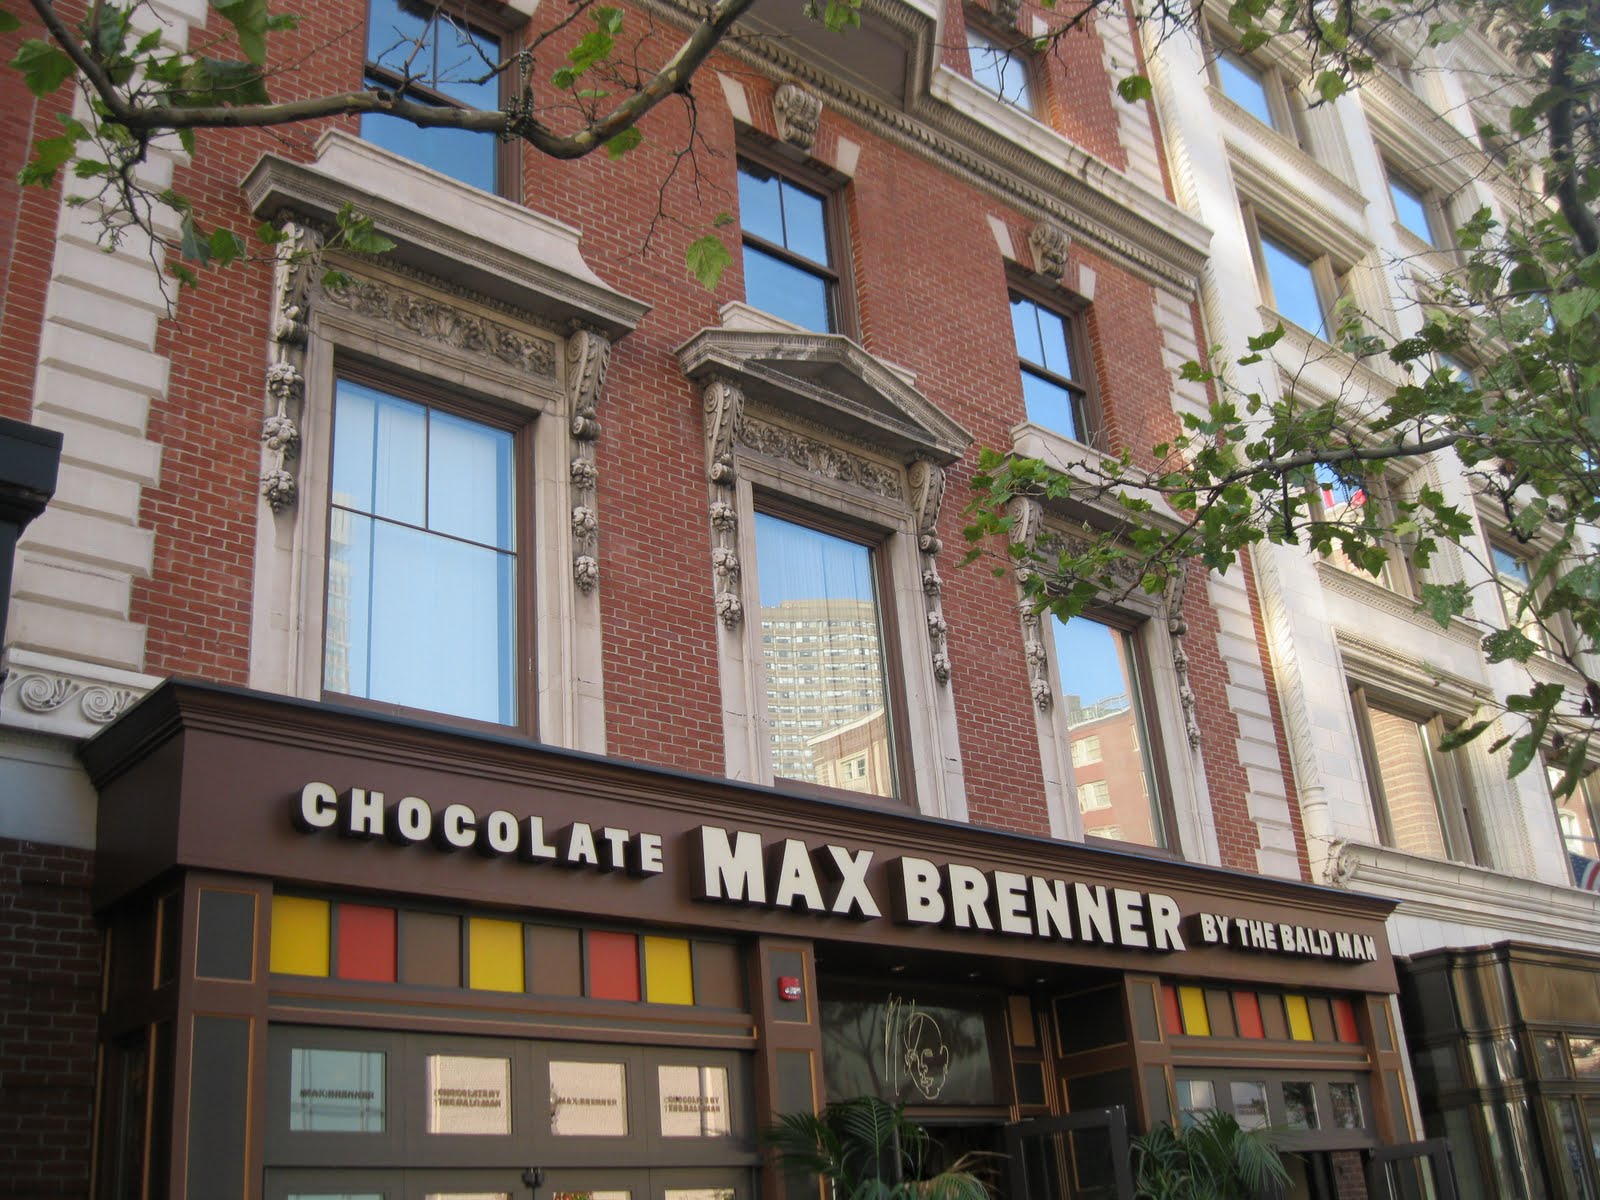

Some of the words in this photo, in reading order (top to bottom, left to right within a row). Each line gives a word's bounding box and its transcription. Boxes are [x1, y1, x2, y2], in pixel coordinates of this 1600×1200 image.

[301, 782, 664, 873] CHOCOLATE
[702, 825, 882, 917] MAX
[902, 856, 1187, 951] BRENNER
[1200, 913, 1229, 944] BY
[1236, 918, 1278, 950] THE
[1279, 924, 1333, 956] BALD
[1335, 932, 1377, 961] MAN
